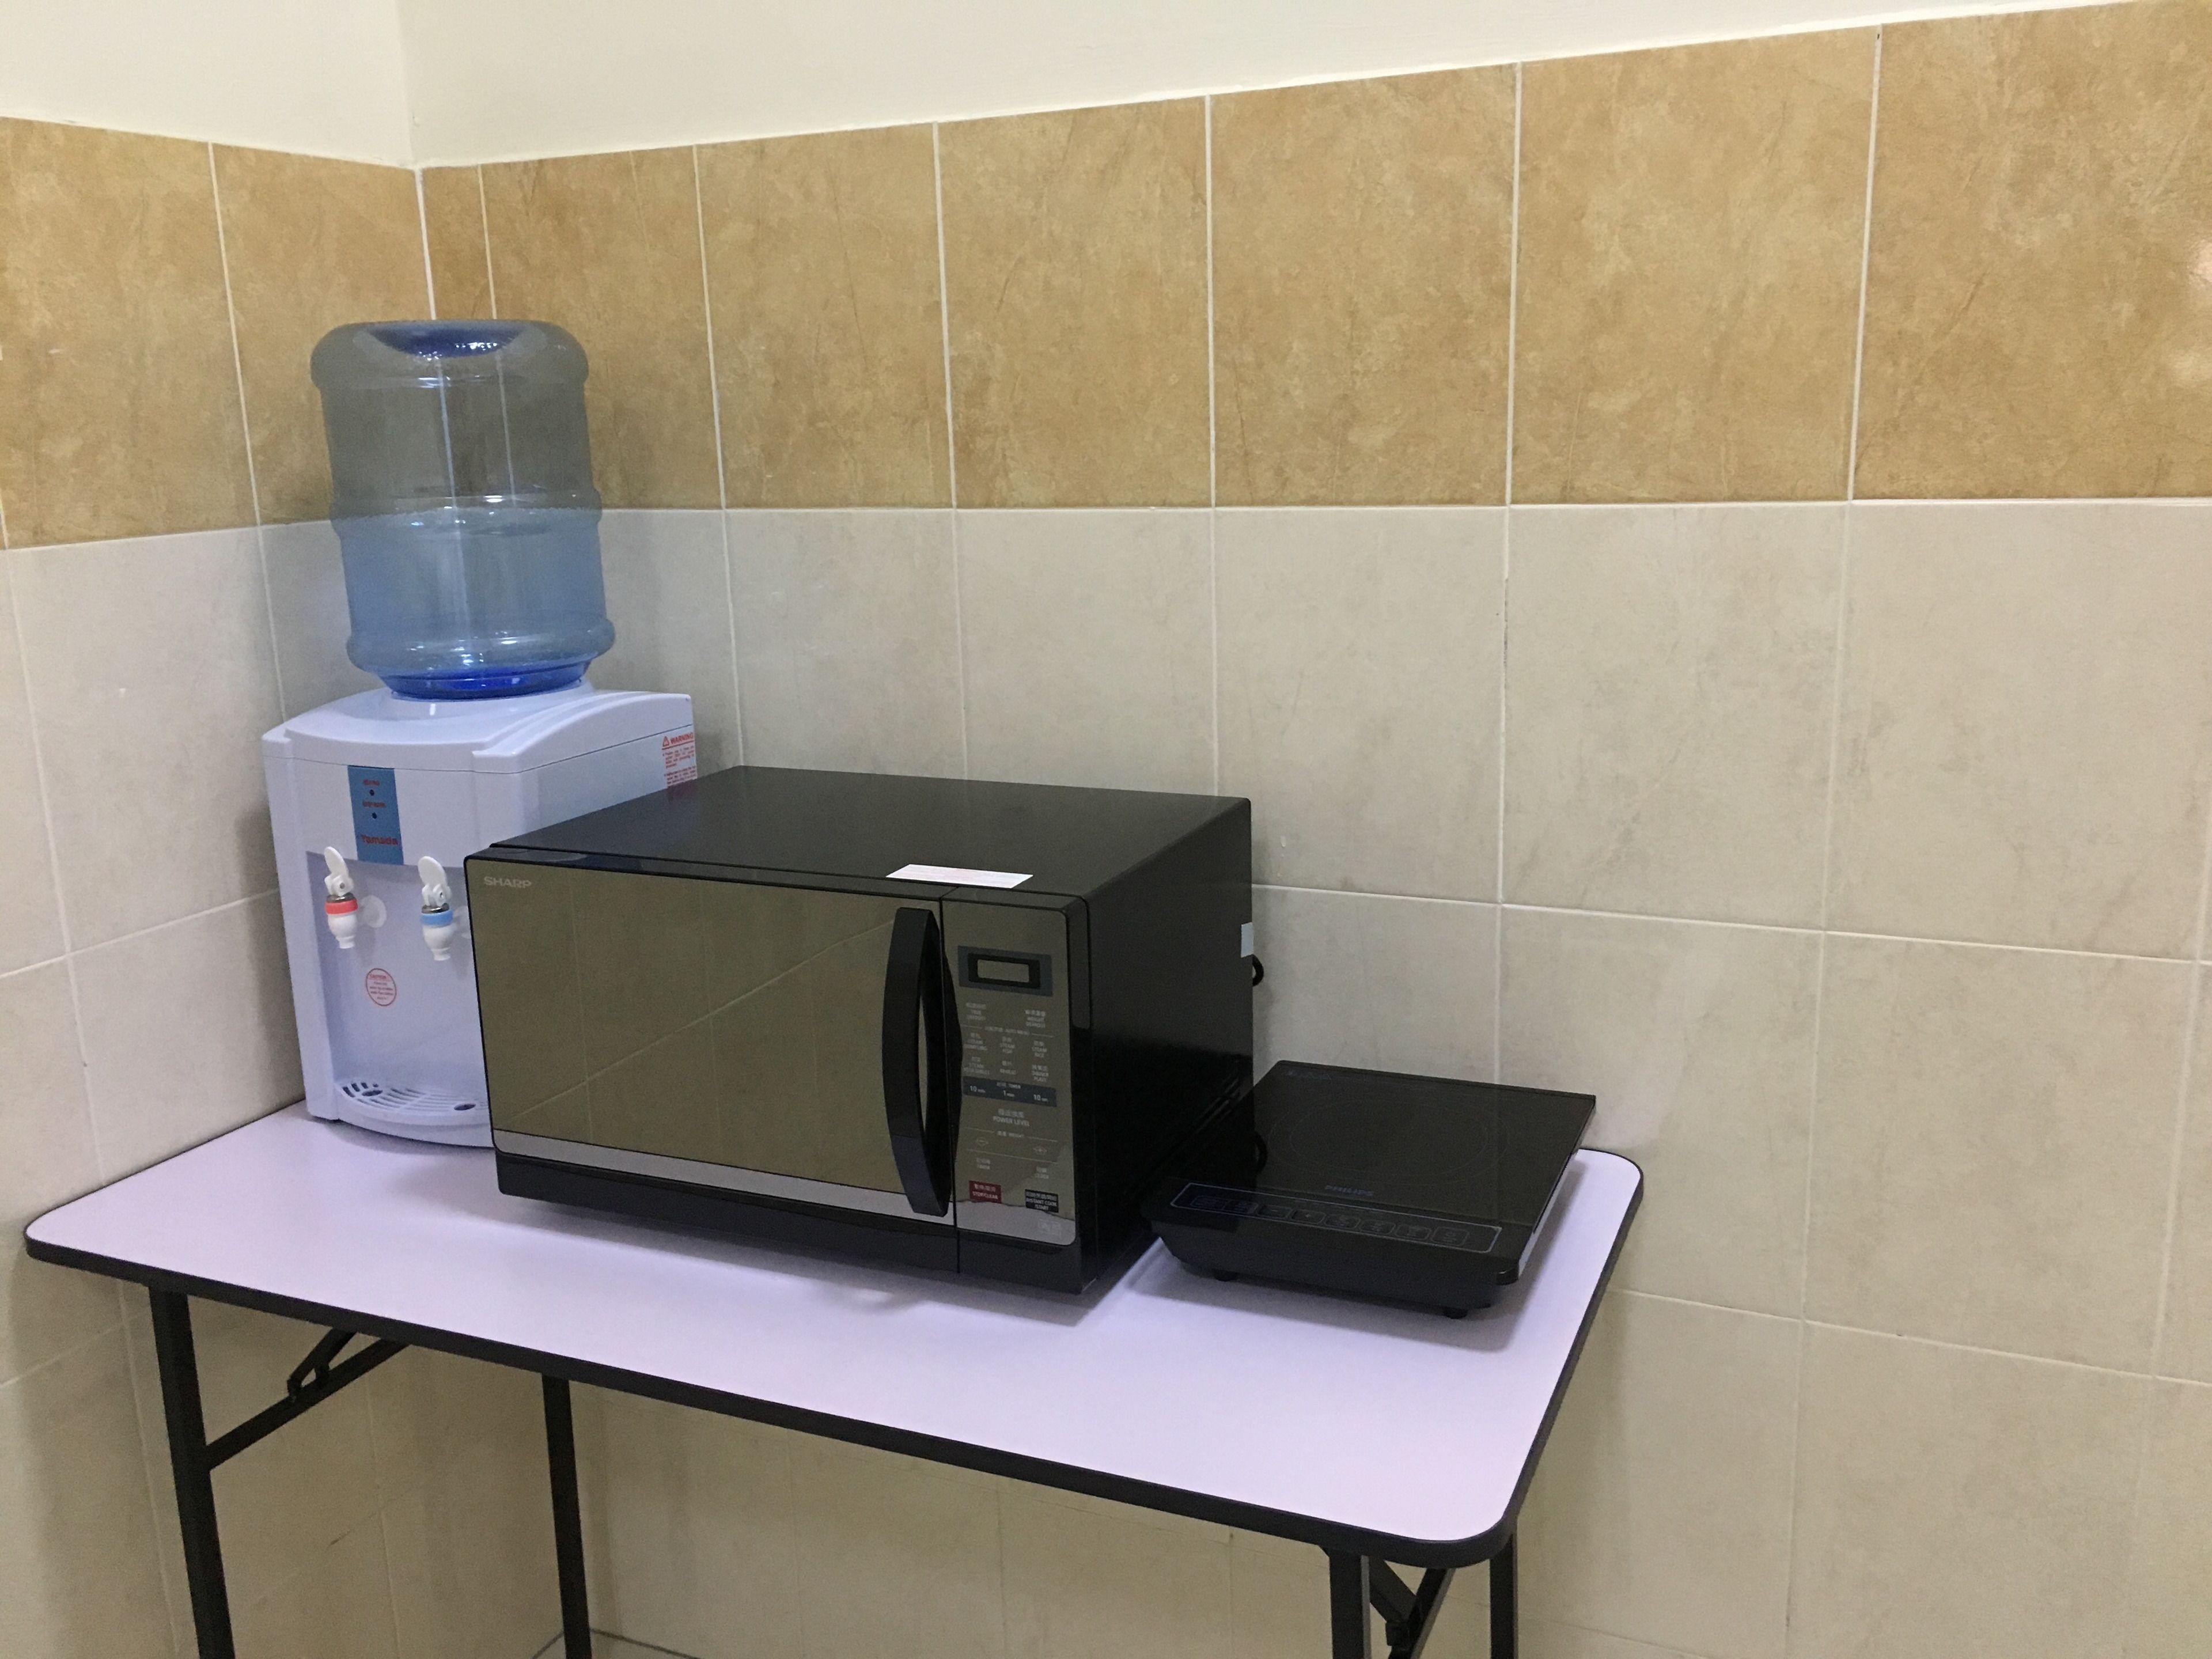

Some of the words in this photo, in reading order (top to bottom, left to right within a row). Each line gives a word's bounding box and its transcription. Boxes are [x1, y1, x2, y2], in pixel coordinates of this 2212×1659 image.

[483, 875, 532, 889] SHARP
[993, 1115, 1013, 1124] POWER
[1013, 1119, 1030, 1127] LEVEL
[1325, 1184, 1374, 1197] PHILIPS
